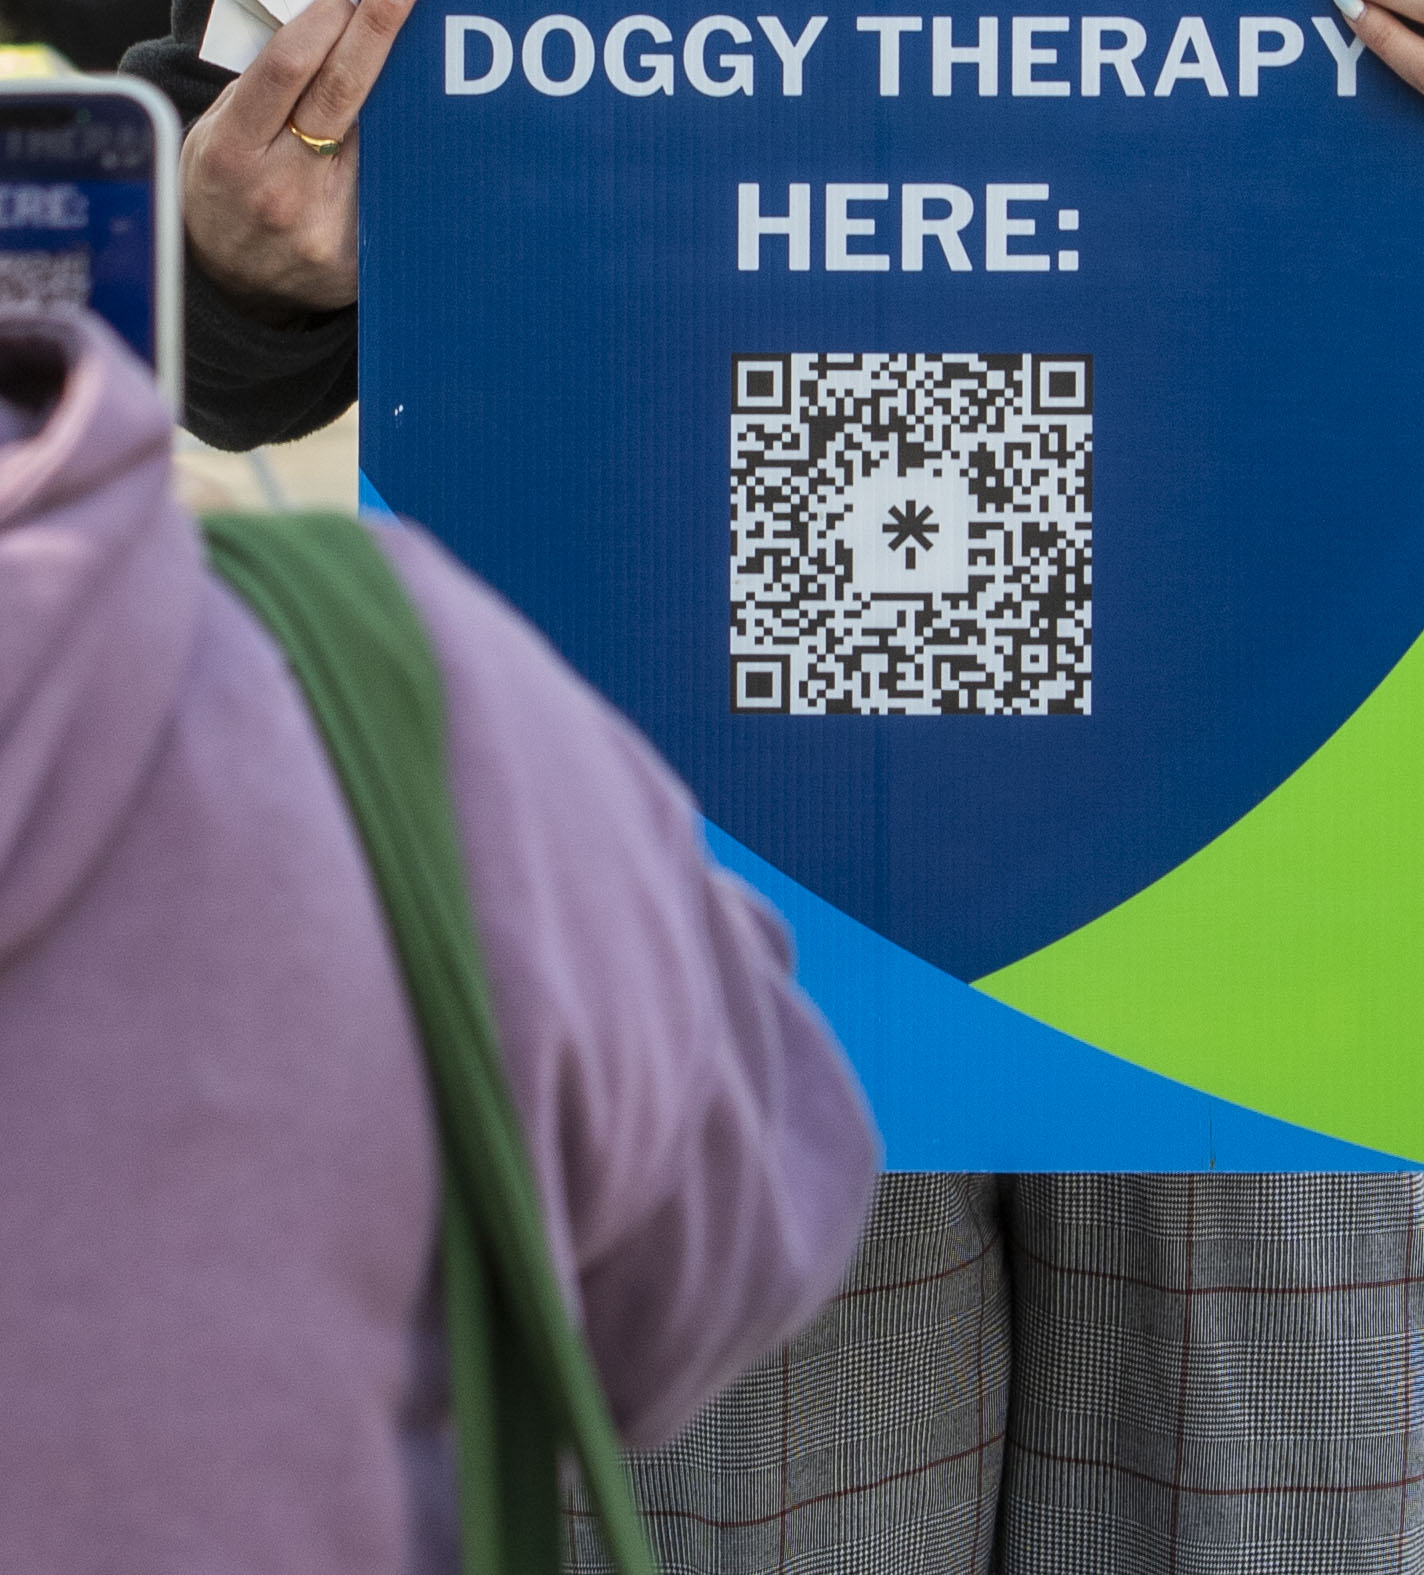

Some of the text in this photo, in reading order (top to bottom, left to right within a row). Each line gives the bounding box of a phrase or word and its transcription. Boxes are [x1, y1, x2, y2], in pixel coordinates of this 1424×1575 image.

[444, 14, 1367, 97] DOGGY THERAPY
[736, 181, 1079, 272] HERE:
